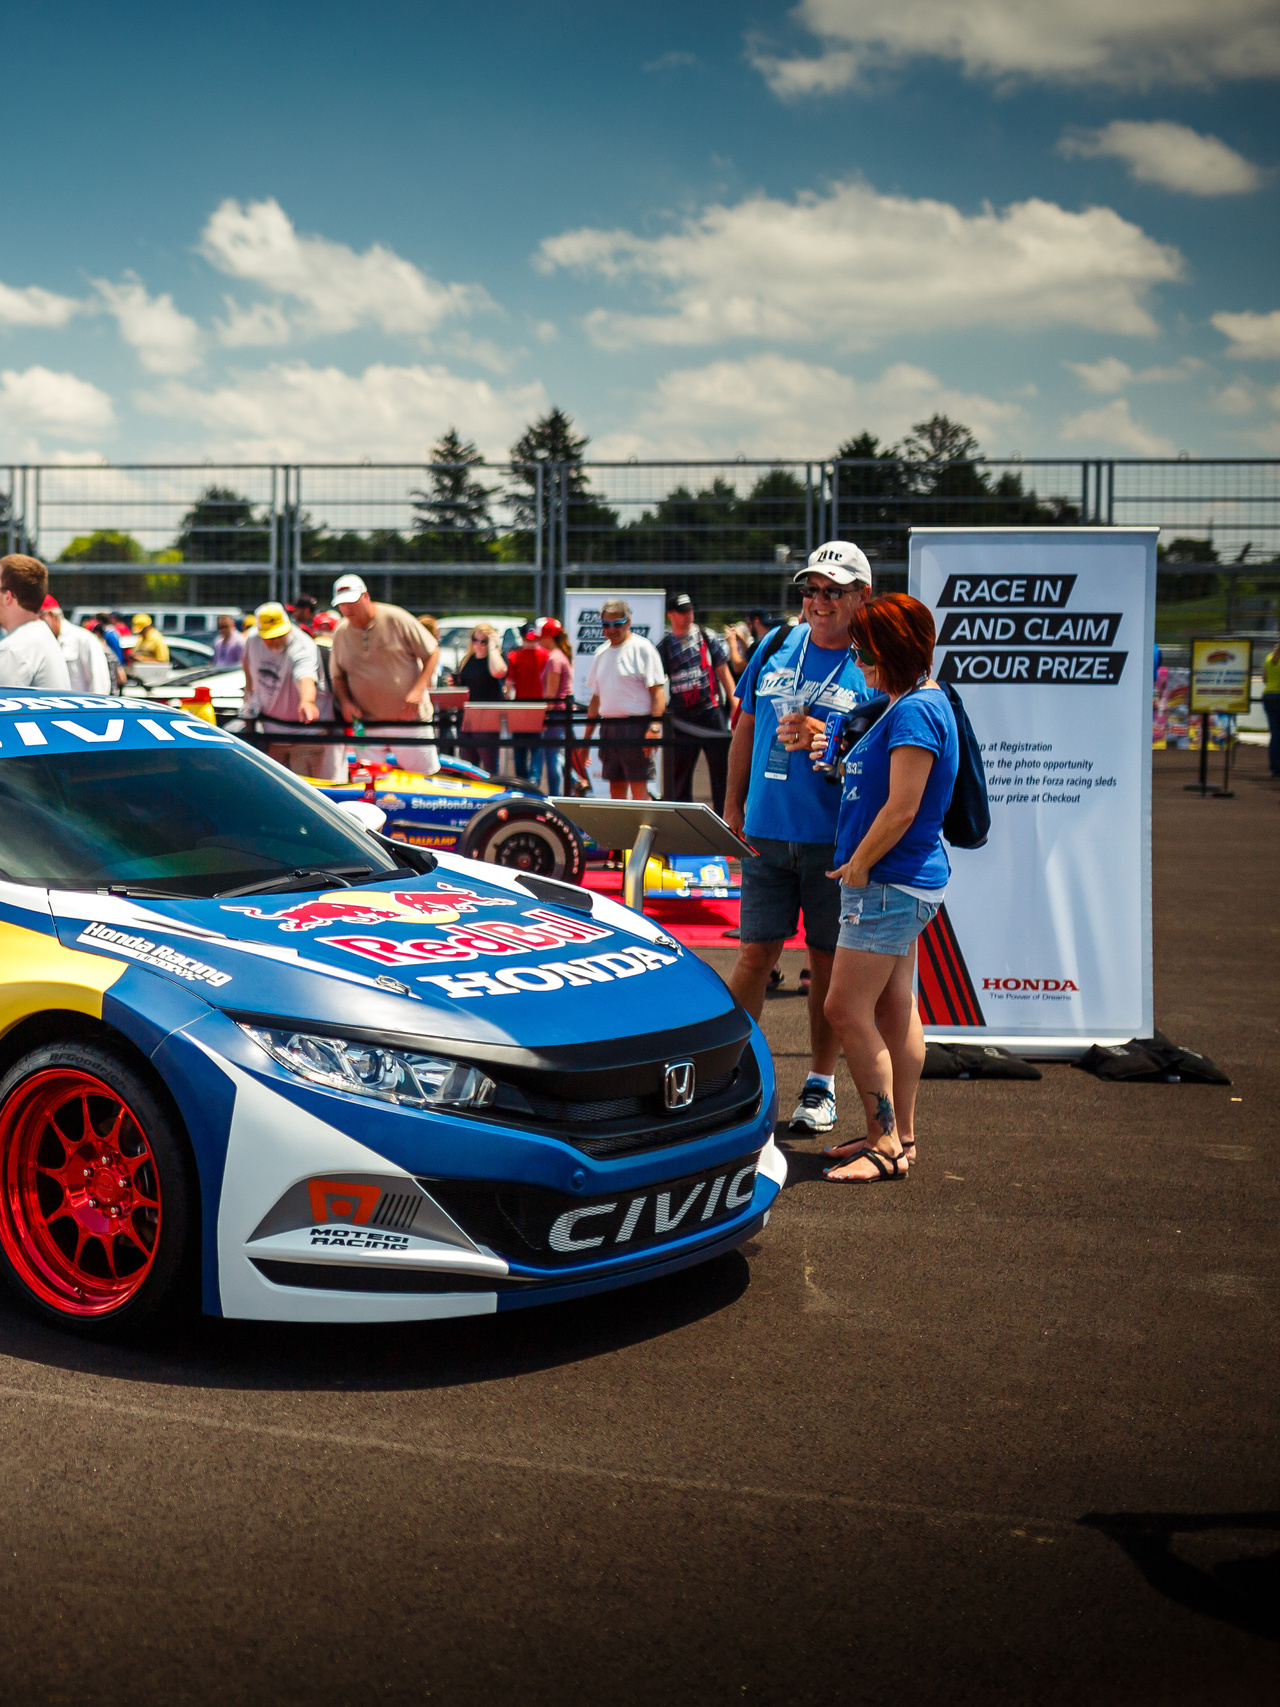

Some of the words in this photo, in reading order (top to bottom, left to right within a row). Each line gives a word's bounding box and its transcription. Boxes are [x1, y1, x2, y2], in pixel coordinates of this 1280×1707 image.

[953, 580, 1027, 603] RACE
[1033, 580, 1063, 603] IN
[950, 618, 1016, 641] AND
[1024, 618, 1110, 641] CLAIM
[953, 656, 1030, 679] YOUR
[1037, 656, 1114, 680] PRIZE.
[988, 742, 997, 752] at
[1000, 741, 1053, 755] Registration
[997, 758, 1012, 769] the
[1014, 758, 1041, 771] photo
[1043, 759, 1094, 772] opportunity
[988, 775, 1011, 786] drive
[1014, 775, 1024, 786] in
[1026, 775, 1040, 786] the
[1042, 776, 1064, 787] Forza
[1066, 776, 1092, 789] racing
[1095, 776, 1117, 787] sleds
[1006, 792, 1029, 805] prize
[1031, 793, 1040, 803] at
[1042, 792, 1081, 803] Checkout
[409, 836, 457, 846] BALKAMP
[83, 922, 155, 953] Honda
[151, 945, 233, 987] Racing
[416, 946, 678, 999] HONDA
[982, 978, 1080, 991] HONDA
[548, 1164, 757, 1252] CIVIC
[310, 1229, 409, 1243] MOTEGI
[311, 1238, 409, 1250] RACING
